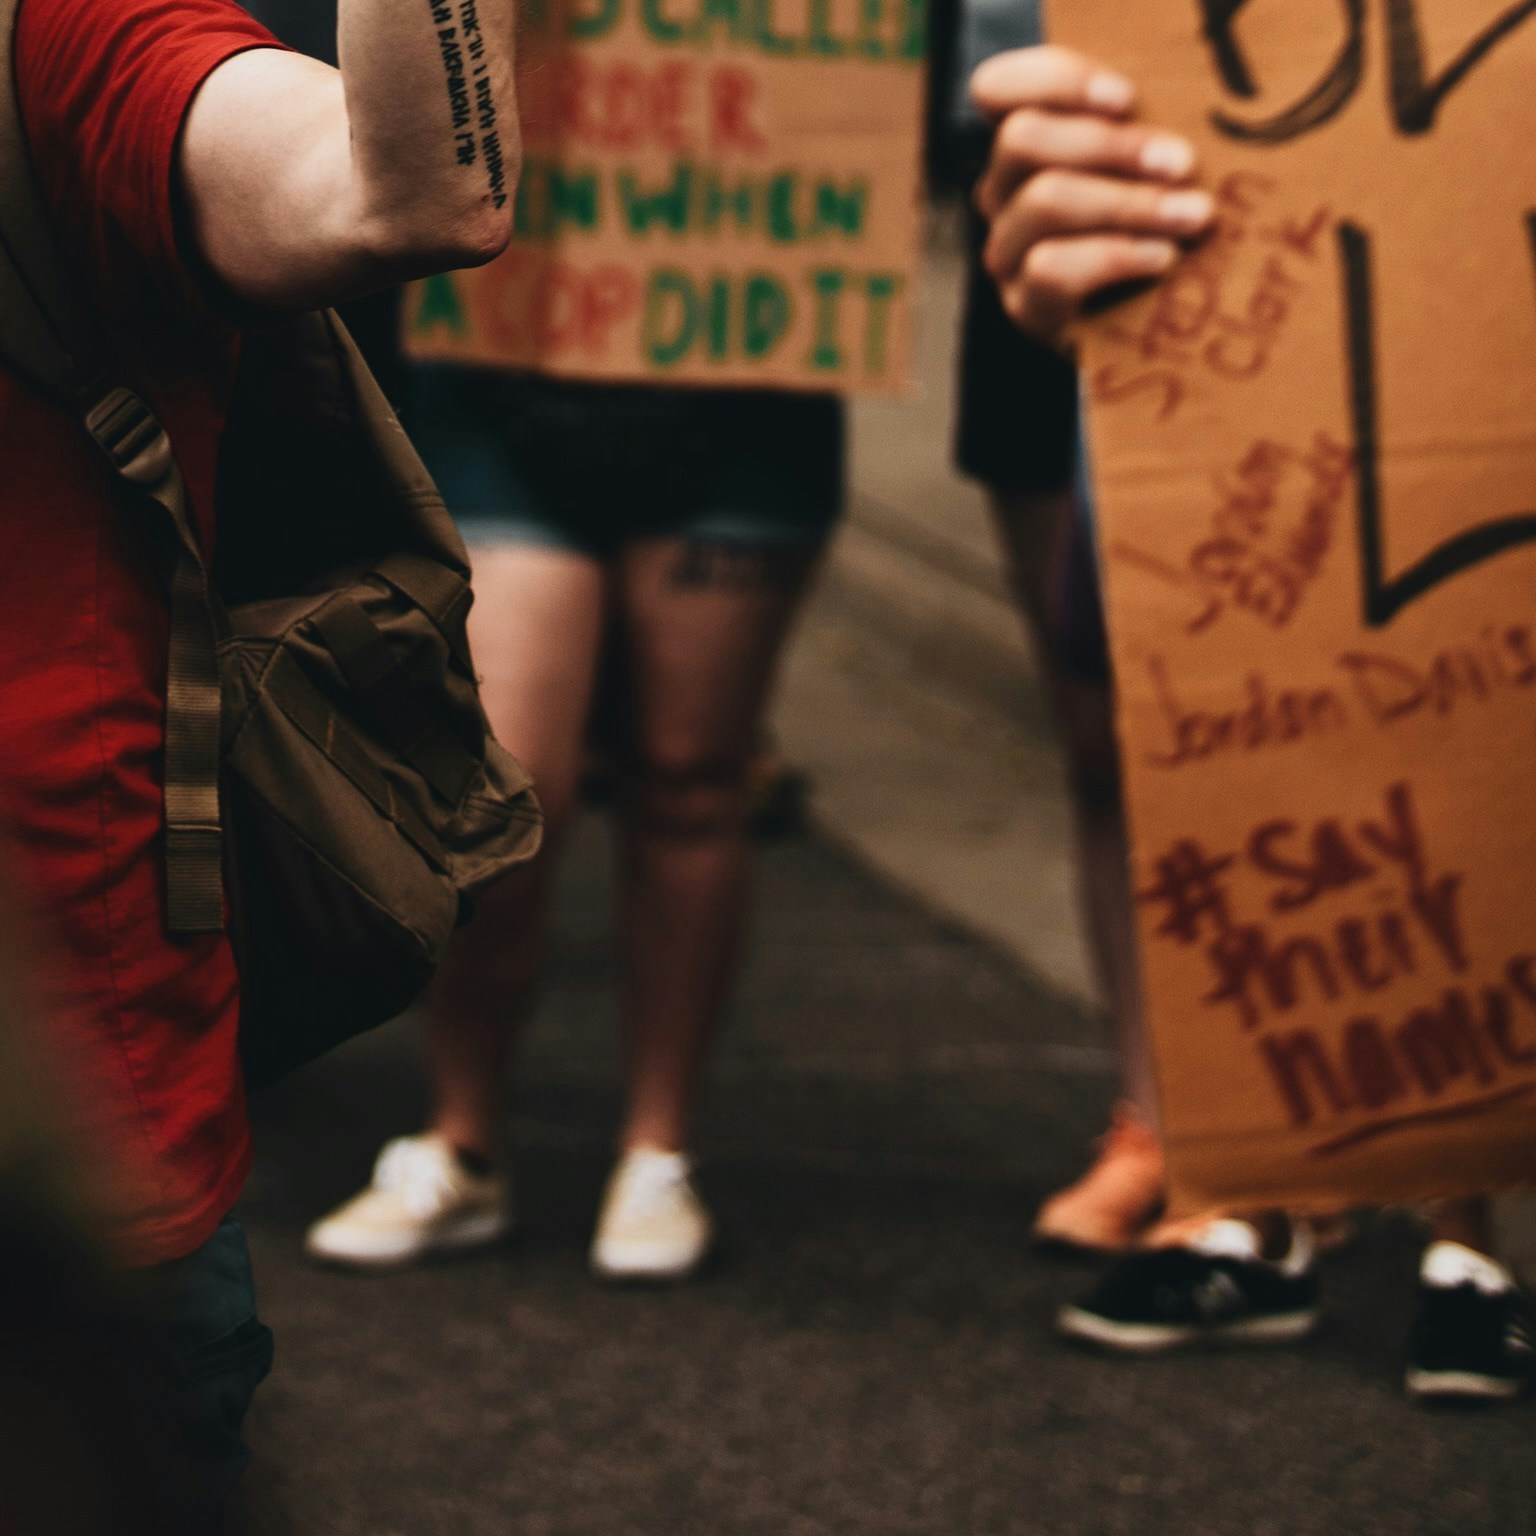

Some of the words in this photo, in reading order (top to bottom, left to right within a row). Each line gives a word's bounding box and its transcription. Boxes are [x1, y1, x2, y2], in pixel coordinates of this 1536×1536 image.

[617, 161, 868, 242] WHEN
[414, 272, 466, 335] A
[476, 252, 641, 356] COP
[642, 270, 792, 368] DID
[806, 270, 904, 376] IT
